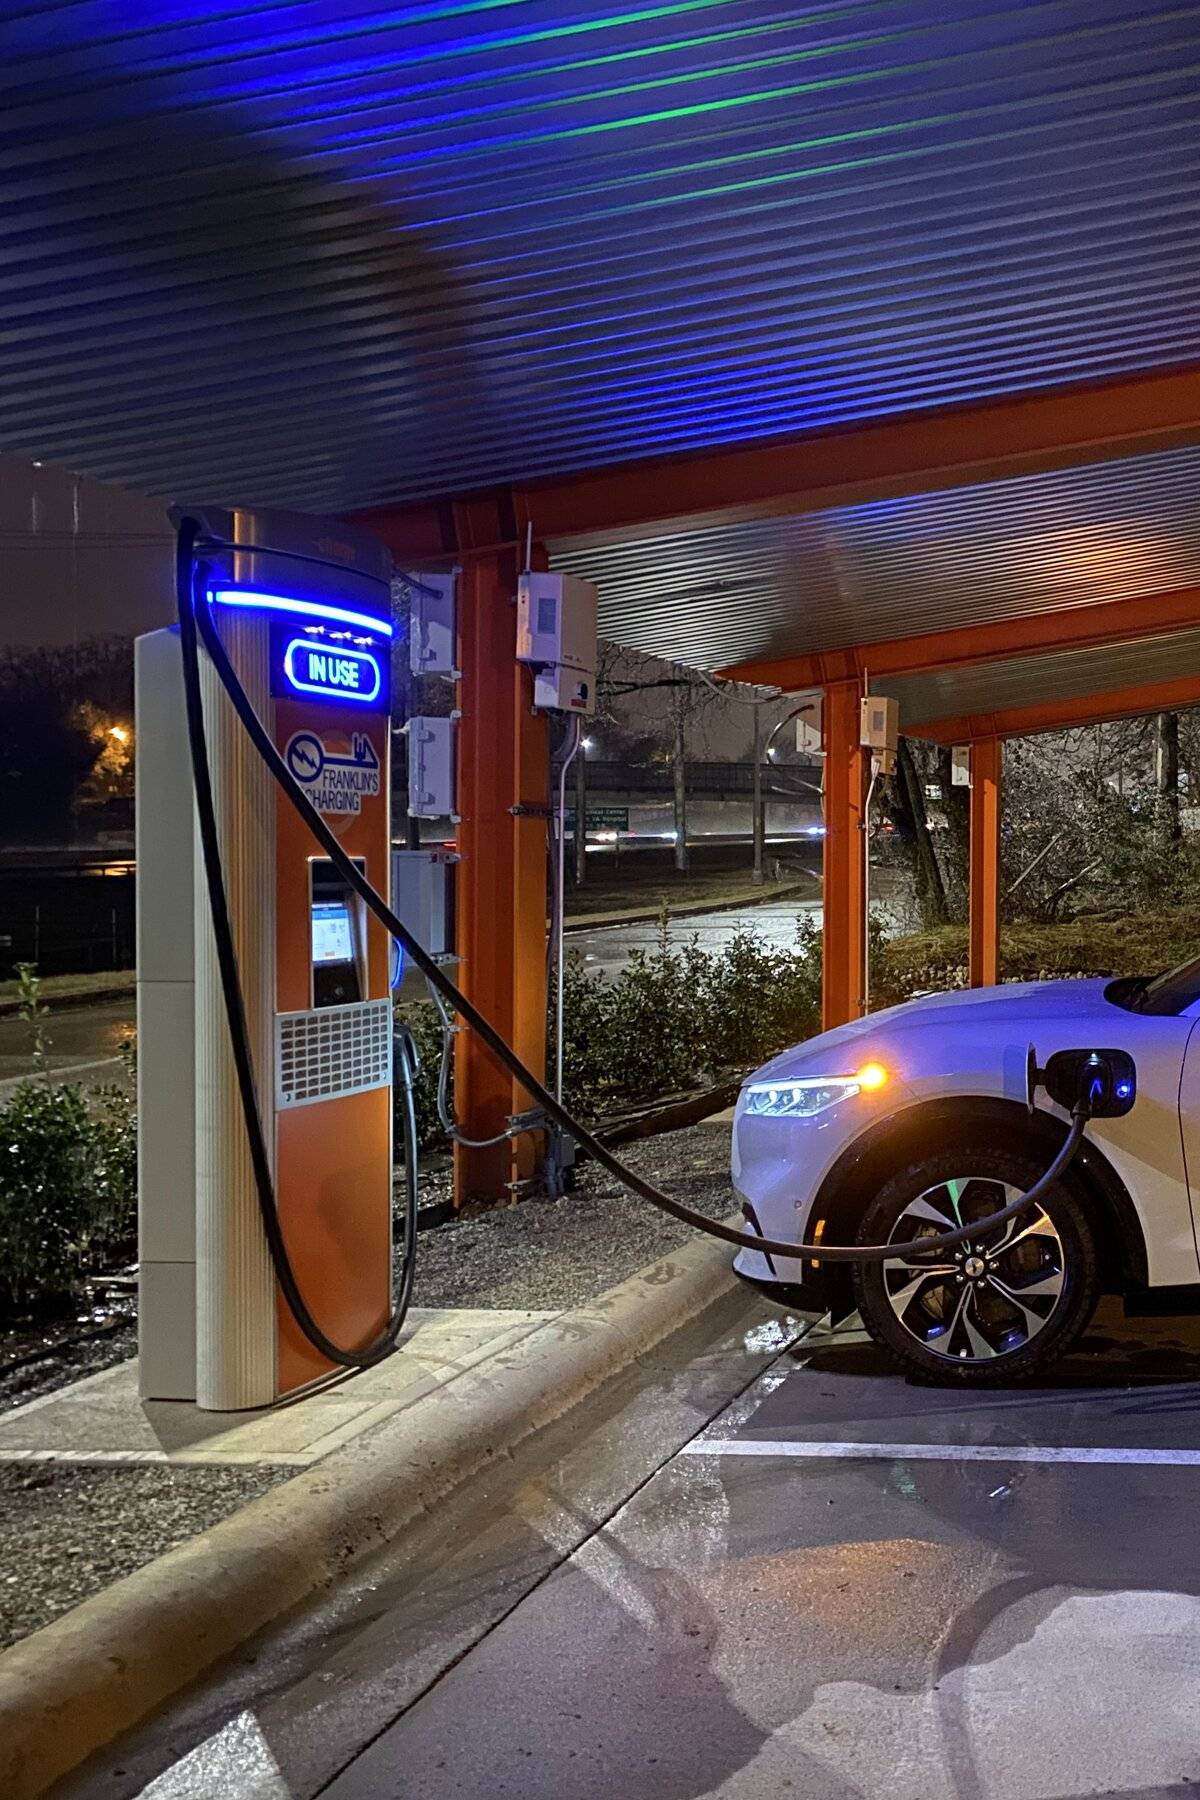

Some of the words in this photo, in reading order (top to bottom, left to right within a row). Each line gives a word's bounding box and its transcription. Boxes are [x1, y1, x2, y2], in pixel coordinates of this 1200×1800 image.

[308, 653, 327, 683] IN
[328, 657, 359, 689] USE
[322, 769, 379, 792] FRANKLIN'S
